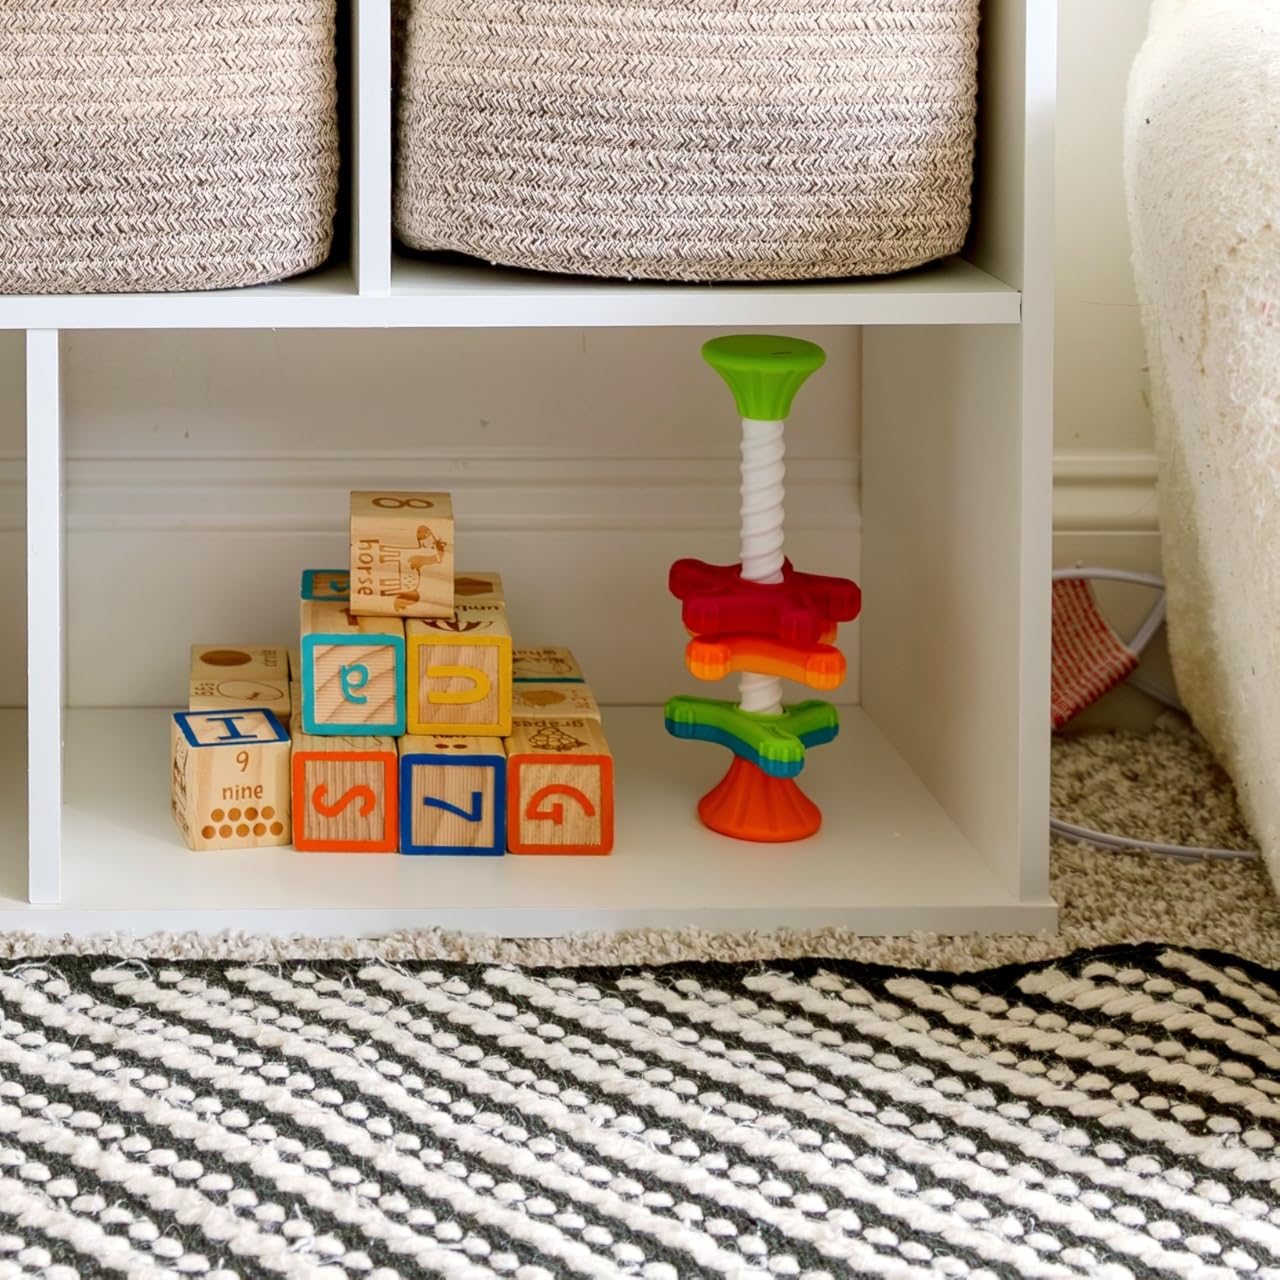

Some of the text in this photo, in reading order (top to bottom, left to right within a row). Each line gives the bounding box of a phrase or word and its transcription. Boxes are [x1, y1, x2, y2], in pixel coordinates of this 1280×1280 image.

[371, 497, 435, 509] 8
[356, 538, 379, 596] horse
[236, 750, 249, 772] 9
[222, 784, 263, 800] nine
[312, 783, 376, 817] S
[423, 791, 482, 822] 7
[526, 783, 596, 826] G
